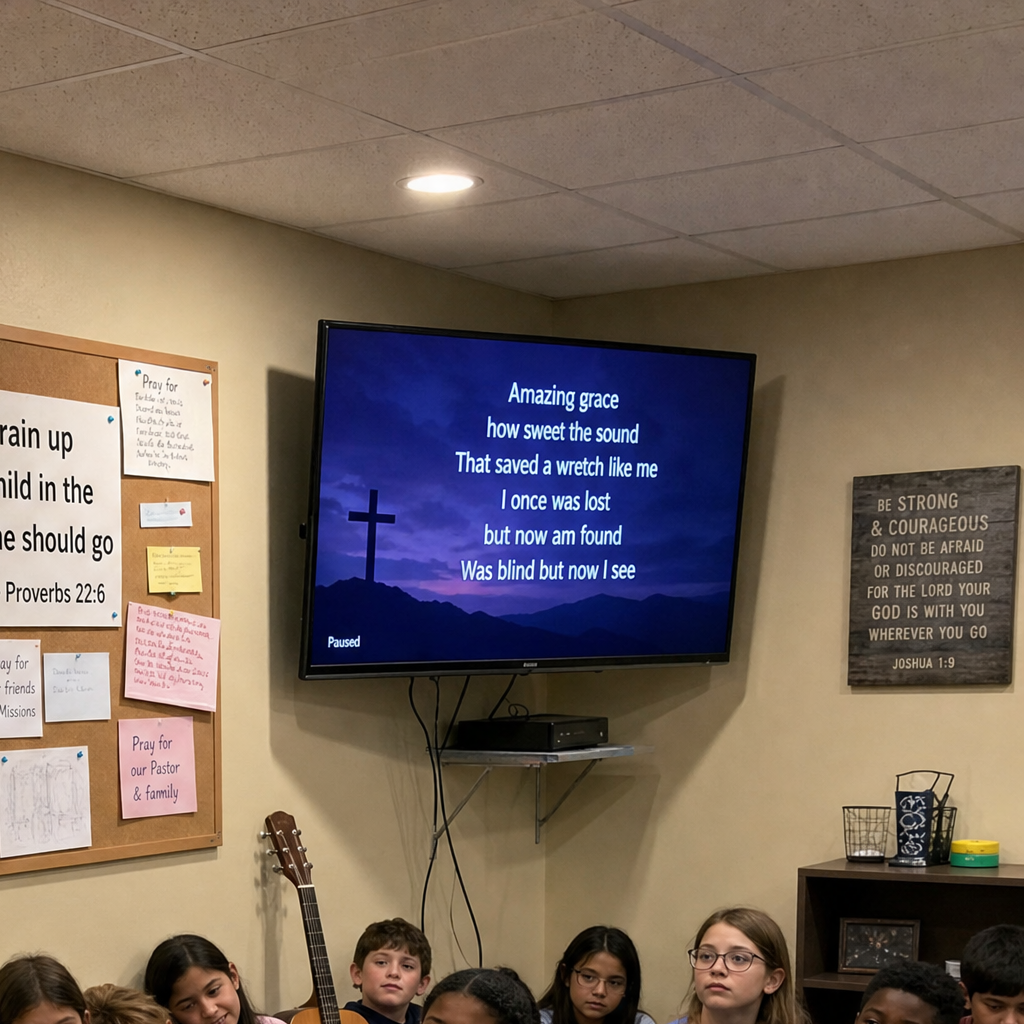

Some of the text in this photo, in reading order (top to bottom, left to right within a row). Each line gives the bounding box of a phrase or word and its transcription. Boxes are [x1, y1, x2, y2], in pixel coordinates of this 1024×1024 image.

[142, 373, 179, 395] Pray for
[508, 382, 620, 413] Amazing grace
[486, 415, 640, 444] how sweet the sound
[49, 430, 72, 459] up
[455, 450, 659, 479] That saved a wretch like me
[40, 473, 56, 501] in
[63, 476, 93, 504] the
[501, 488, 612, 512] I once was lost
[877, 492, 959, 512] BE STRONG
[483, 523, 623, 546] but now am found
[870, 514, 989, 537] & COURAGEOUS
[23, 524, 85, 553] should
[92, 535, 113, 561] go
[870, 538, 984, 558] DO NOT BE AFRAID
[460, 558, 636, 581] Was blind but now I see
[874, 559, 983, 578] OR DISCOURAGED
[5, 581, 72, 604] Proverbs
[75, 582, 106, 604] 22:6
[867, 581, 991, 599] FOR THE LORD YOUR
[871, 603, 985, 621] GOD IS WITH YOU
[327, 635, 361, 648] Paused
[868, 624, 988, 642] WHEREVER YOU GO
[14, 654, 30, 670] for
[892, 656, 955, 670] JOSHUA 1:9
[4, 679, 36, 695] friends
[132, 733, 173, 757] Pray for
[130, 759, 181, 777] our Pastor
[132, 785, 142, 802] &
